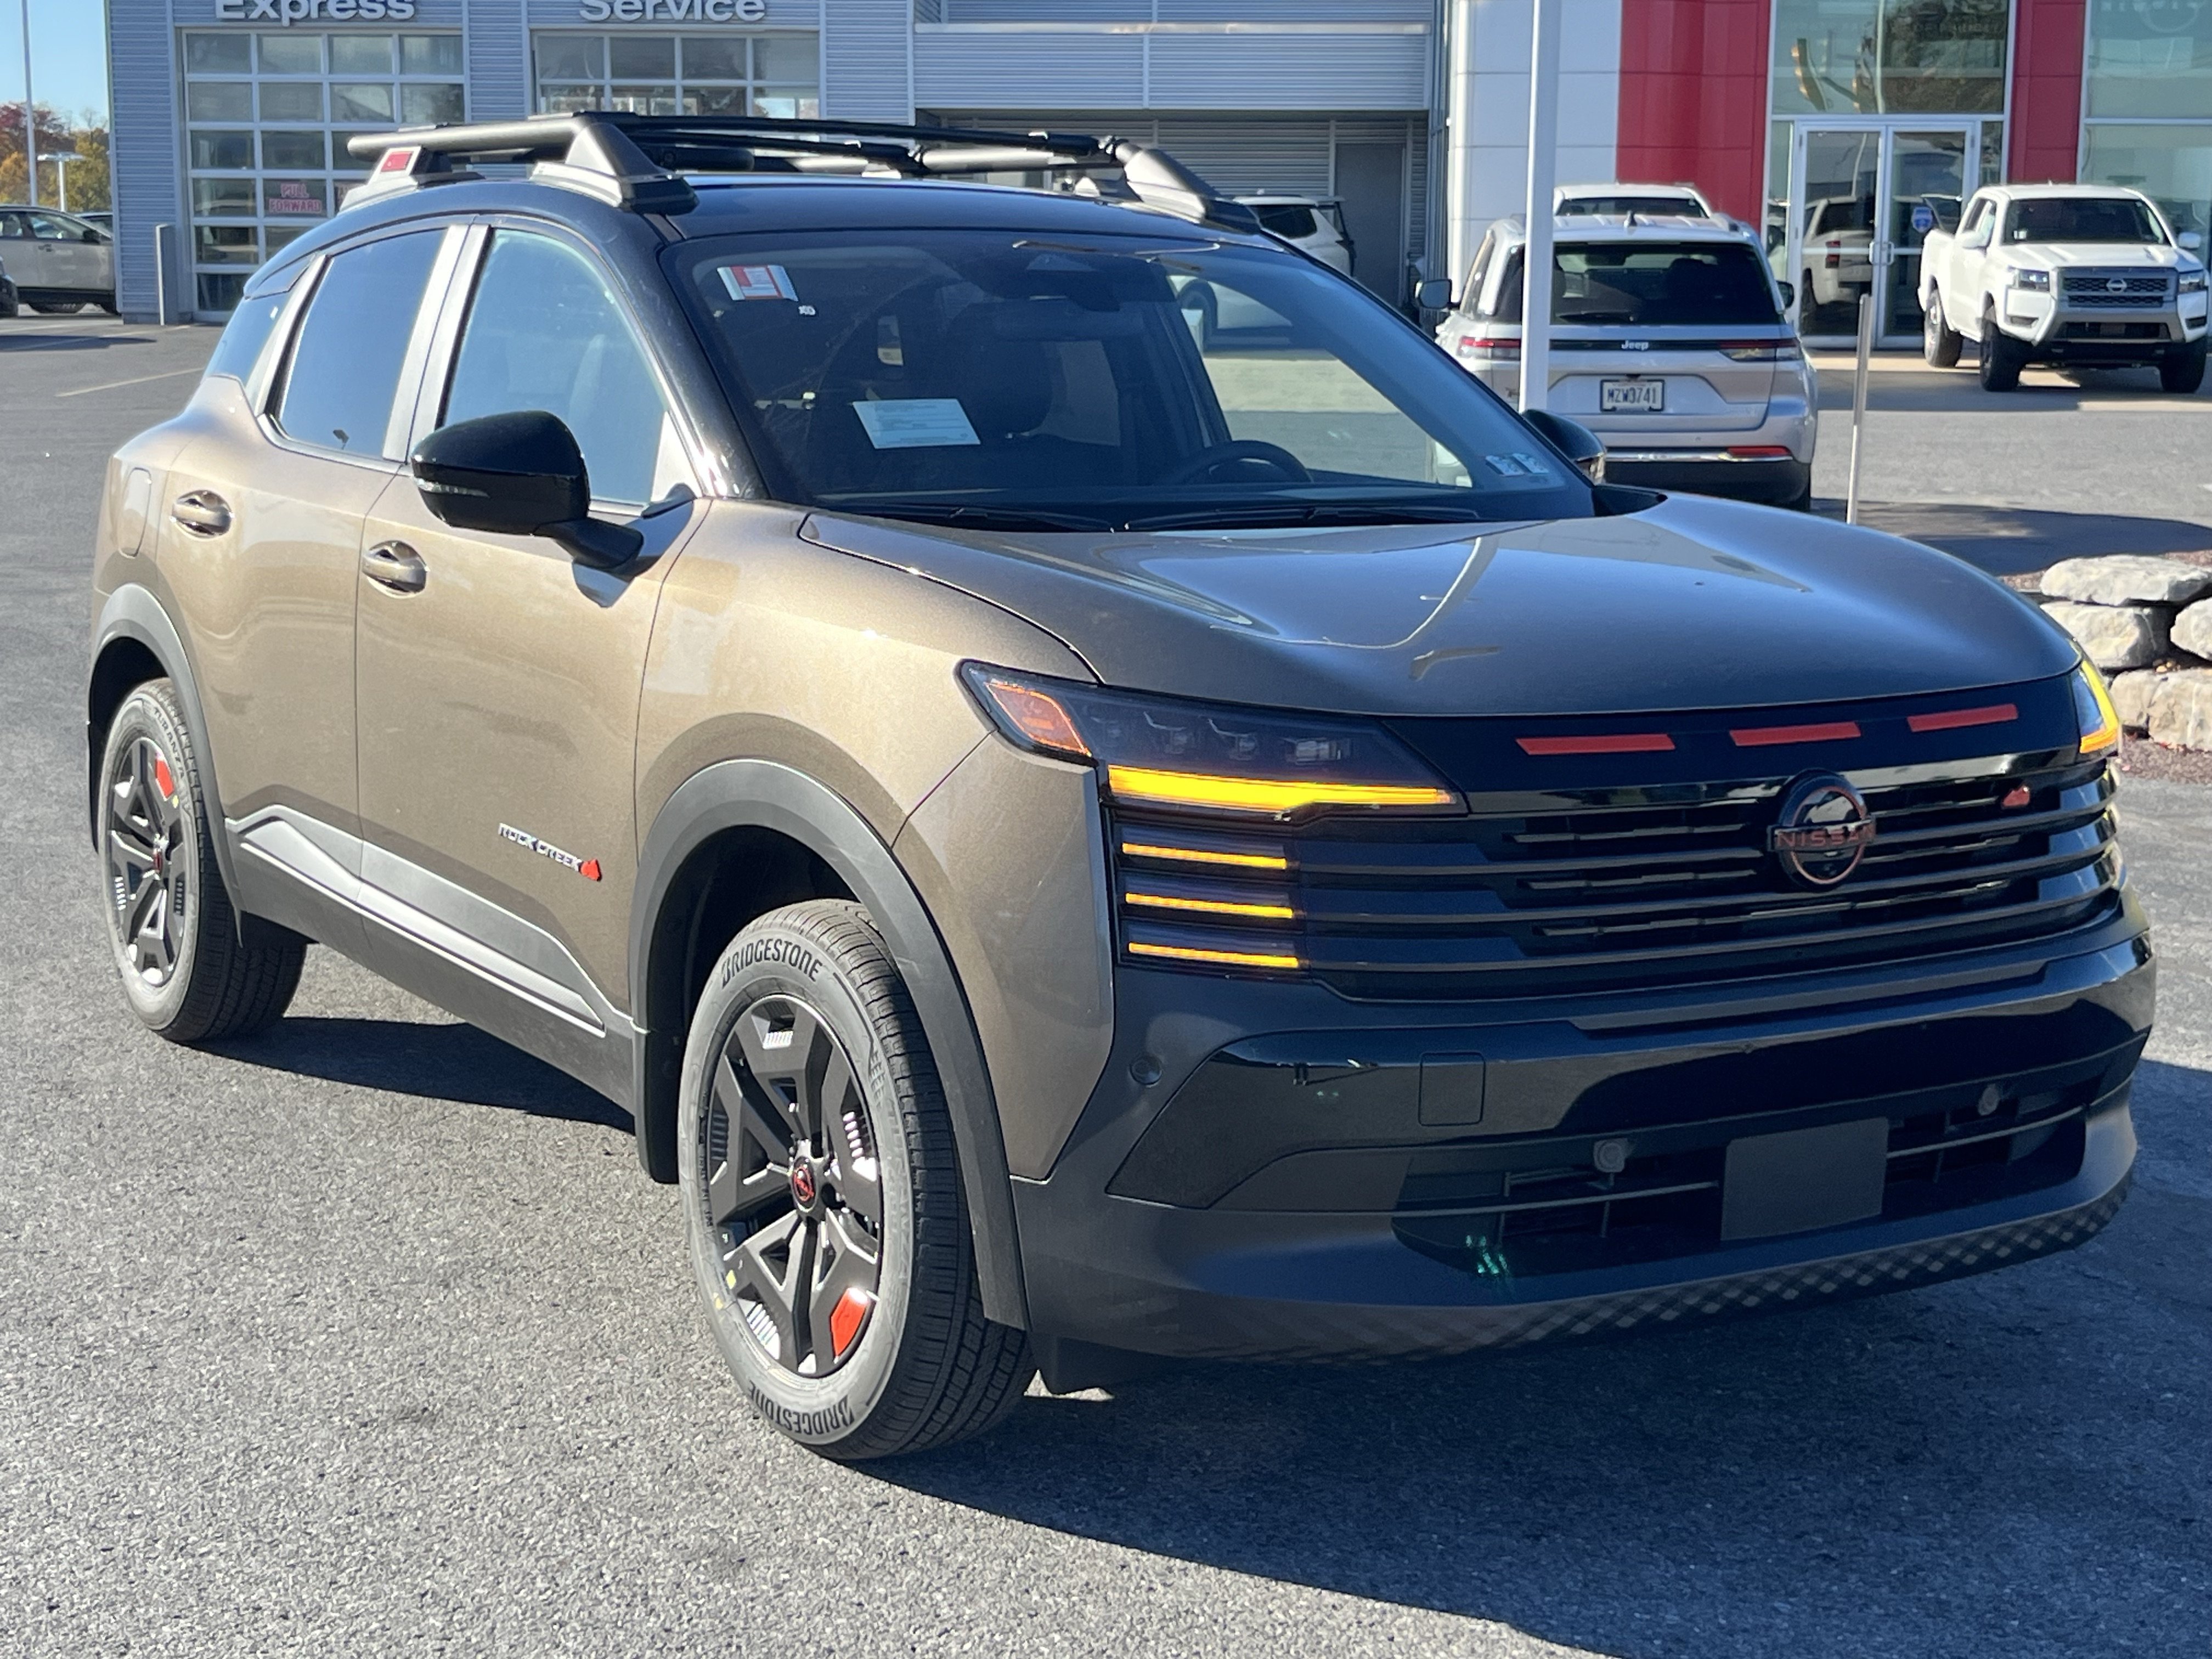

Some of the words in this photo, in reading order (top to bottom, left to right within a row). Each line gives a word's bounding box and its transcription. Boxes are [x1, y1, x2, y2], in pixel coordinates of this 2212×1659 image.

[216, 0, 415, 26] Express
[579, 0, 765, 21] Service
[280, 183, 309, 198] PULL
[268, 199, 322, 213] FORWARD
[1621, 340, 1649, 351] Jeep
[498, 822, 538, 851] ROCK
[535, 840, 583, 872] CREEK
[1775, 822, 1875, 848] NISSAN
[721, 938, 823, 990] BRIDGESTONE
[747, 1379, 855, 1435] BRIDGESTONE
